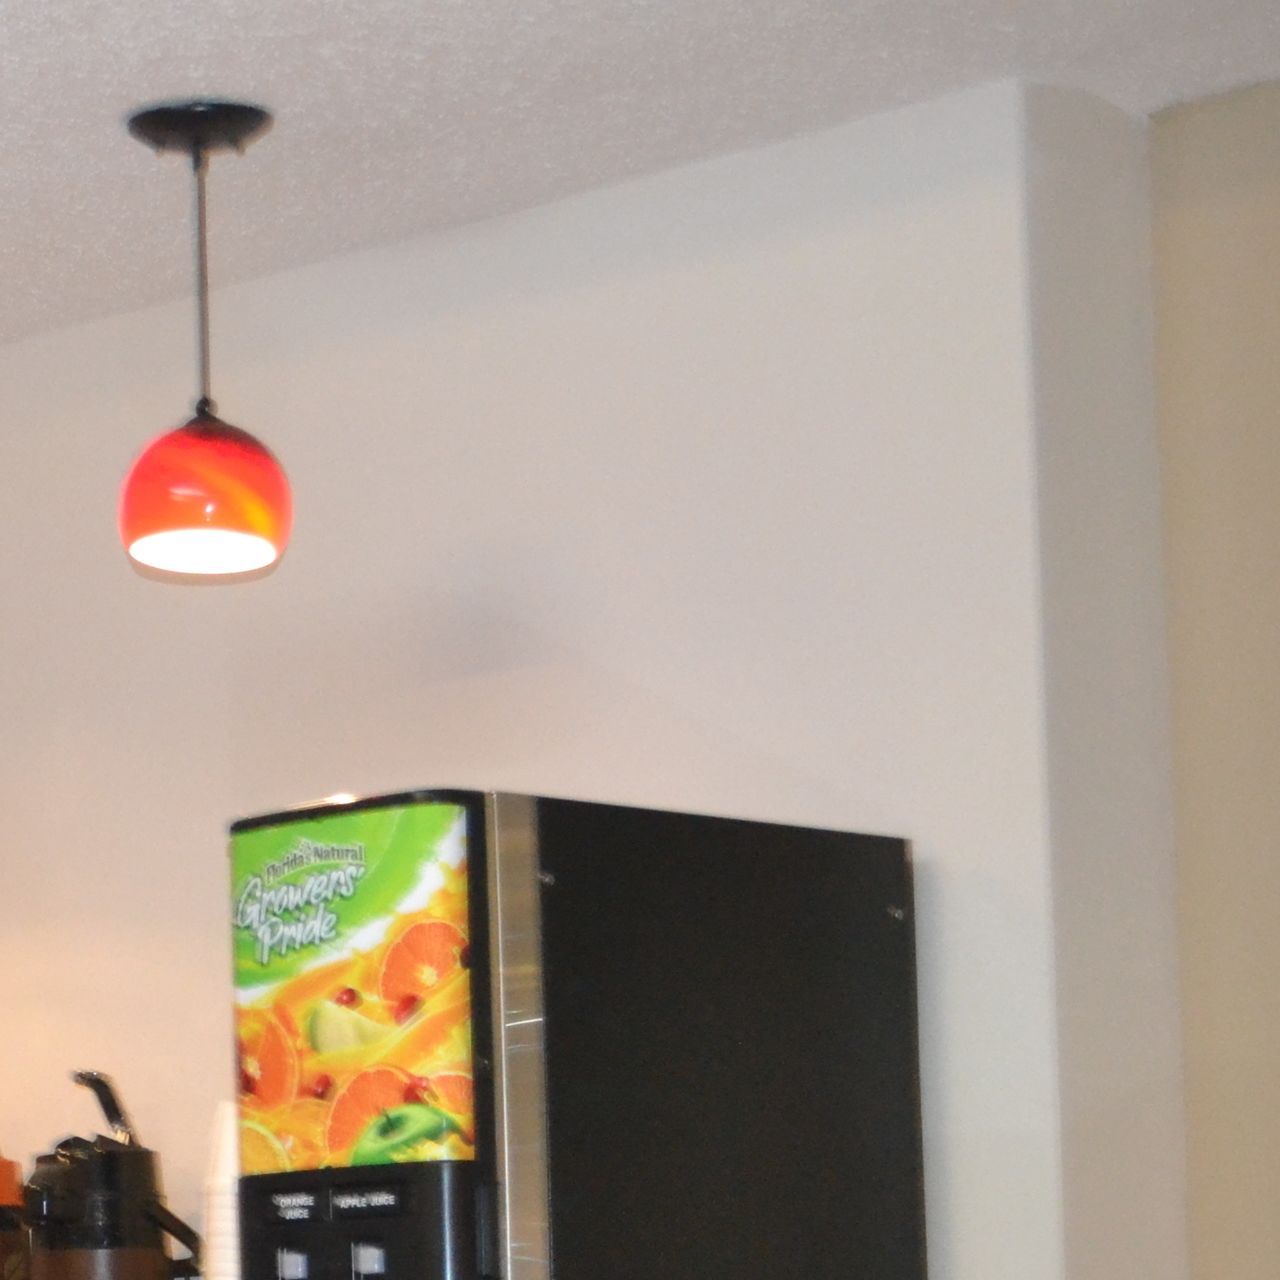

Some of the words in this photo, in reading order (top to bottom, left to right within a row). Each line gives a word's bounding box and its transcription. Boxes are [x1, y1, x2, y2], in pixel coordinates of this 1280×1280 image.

[313, 845, 365, 865] Natural
[256, 903, 337, 965] Pride
[275, 1193, 315, 1208] ORANGE
[336, 1194, 367, 1209] APPLE
[366, 1191, 395, 1206] JUICE
[281, 1207, 309, 1220] JUICE
